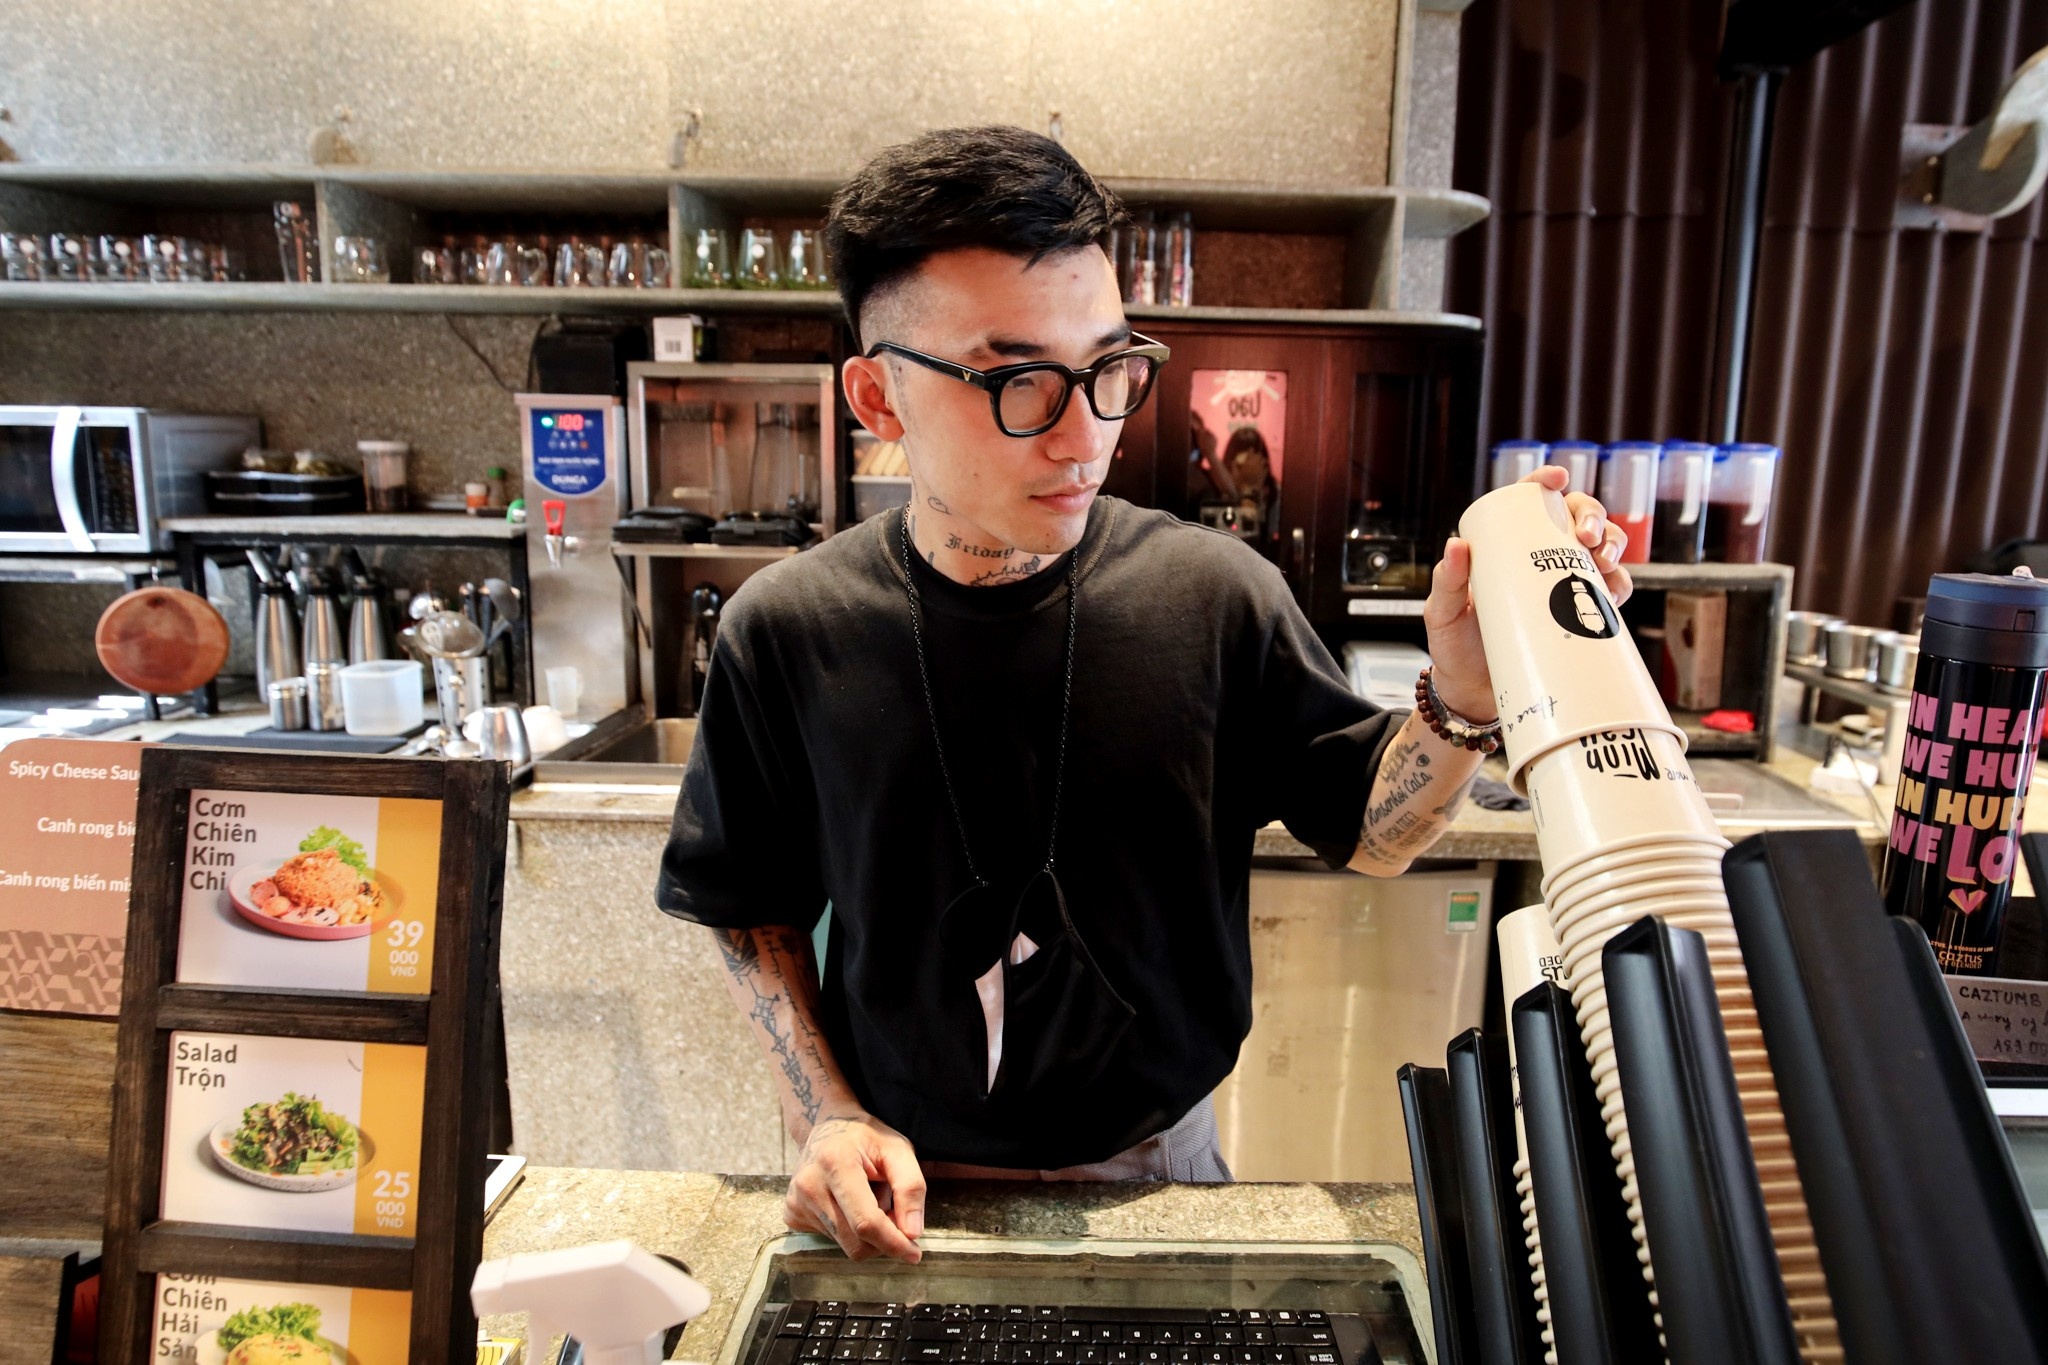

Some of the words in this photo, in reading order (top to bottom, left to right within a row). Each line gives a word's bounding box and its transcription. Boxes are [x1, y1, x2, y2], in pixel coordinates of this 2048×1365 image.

[1530, 548, 1577, 560] BLENDED
[1533, 556, 1596, 573] caztus
[1909, 691, 1938, 732] IN
[9, 760, 50, 780] Spicy
[52, 763, 108, 779] Cheese
[1904, 732, 1954, 779] WE
[1965, 750, 2037, 790] HU
[195, 797, 246, 818] Cơm
[1896, 773, 1926, 815] IN
[1935, 788, 2027, 831] HUR
[37, 817, 76, 833] Canh
[79, 821, 115, 838] rong
[193, 822, 257, 843] Chiên
[192, 846, 235, 866] Kim
[1891, 810, 1942, 864] WE
[1947, 824, 2023, 885] LO
[0, 870, 32, 887] Canh
[35, 875, 70, 892] rong
[73, 873, 106, 891] biển
[190, 870, 227, 891] Chi
[386, 919, 424, 947] 39
[389, 950, 419, 965] 000
[389, 966, 417, 977] VND
[176, 1041, 238, 1064] Salad
[175, 1066, 226, 1091] Trộn
[372, 1170, 411, 1199] 25
[376, 1200, 406, 1217] 000
[376, 1216, 404, 1228] VND
[162, 1287, 227, 1312] Chiên
[161, 1312, 199, 1334] Hải
[158, 1337, 198, 1360] Sản
